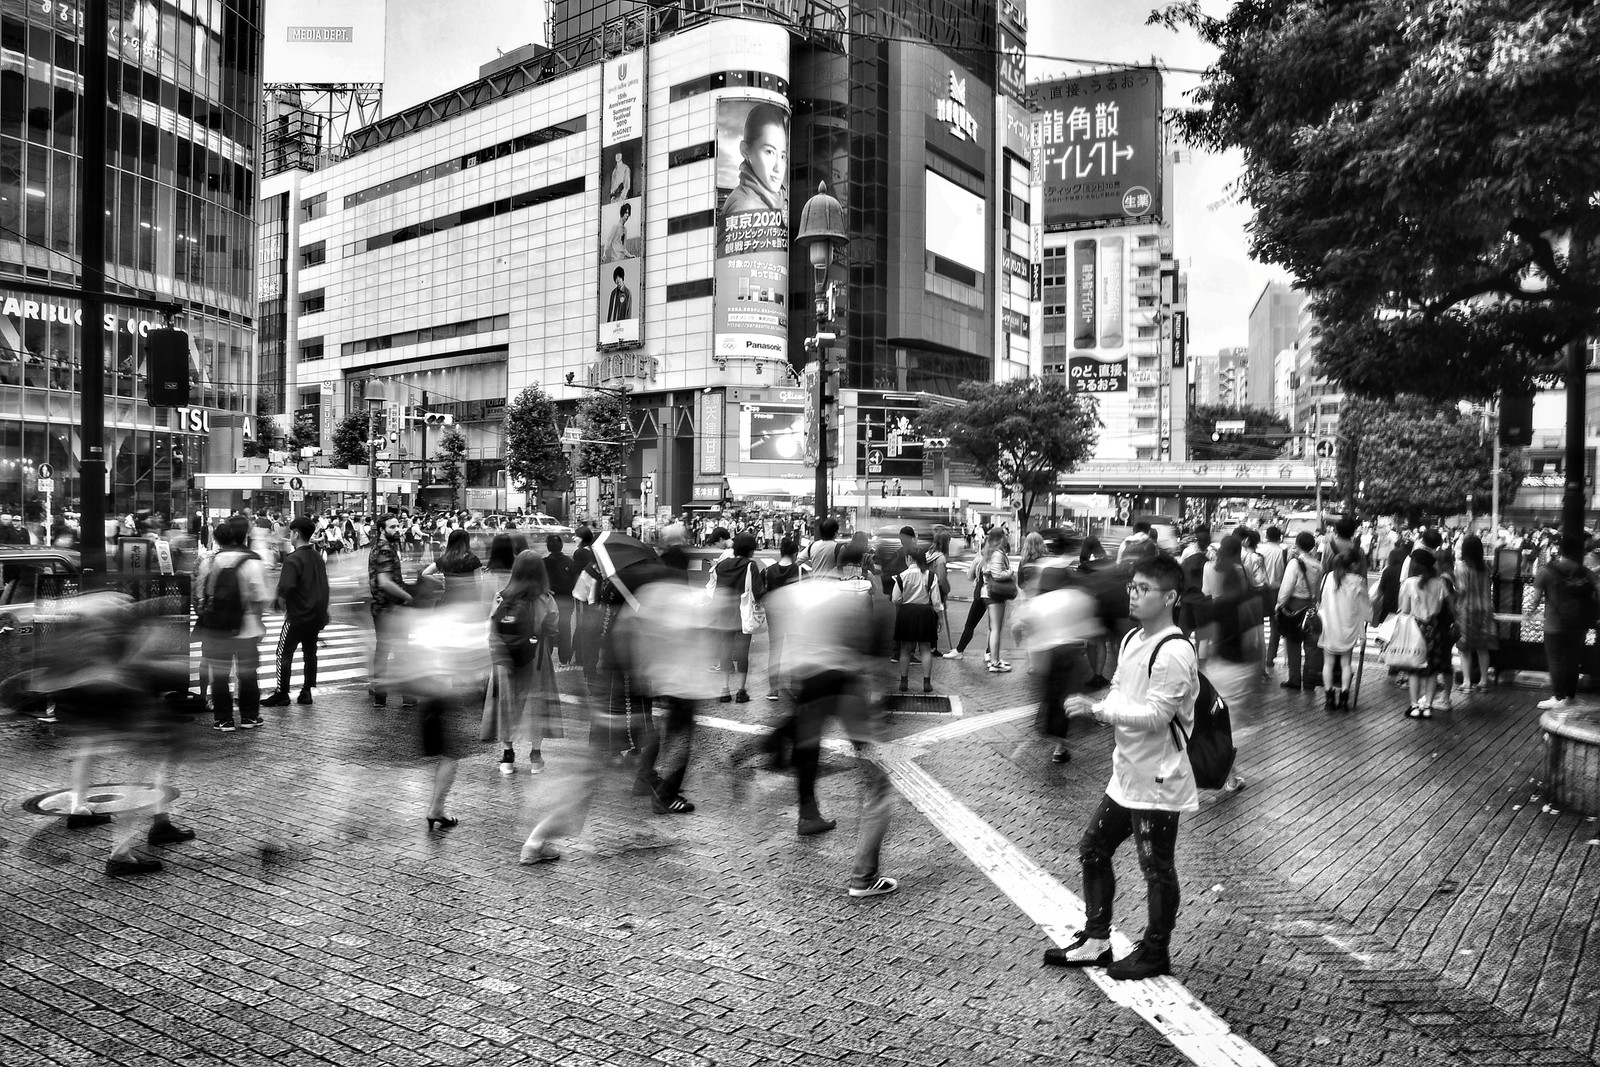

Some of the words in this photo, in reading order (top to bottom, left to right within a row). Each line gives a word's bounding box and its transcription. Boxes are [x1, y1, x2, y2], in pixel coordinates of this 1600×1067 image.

[292, 29, 321, 40] MEDIA
[323, 29, 349, 40] DEPT.
[608, 96, 637, 110] Anniversary
[612, 106, 632, 116] Summer
[612, 111, 631, 122] Festival
[1043, 100, 1119, 145] 龍角散
[611, 126, 632, 138] MAGNET
[725, 211, 782, 232] 東京2020
[746, 340, 782, 351] Panasonic
[1076, 378, 1119, 392] うるおう
[705, 406, 717, 471] 天津甘栗
